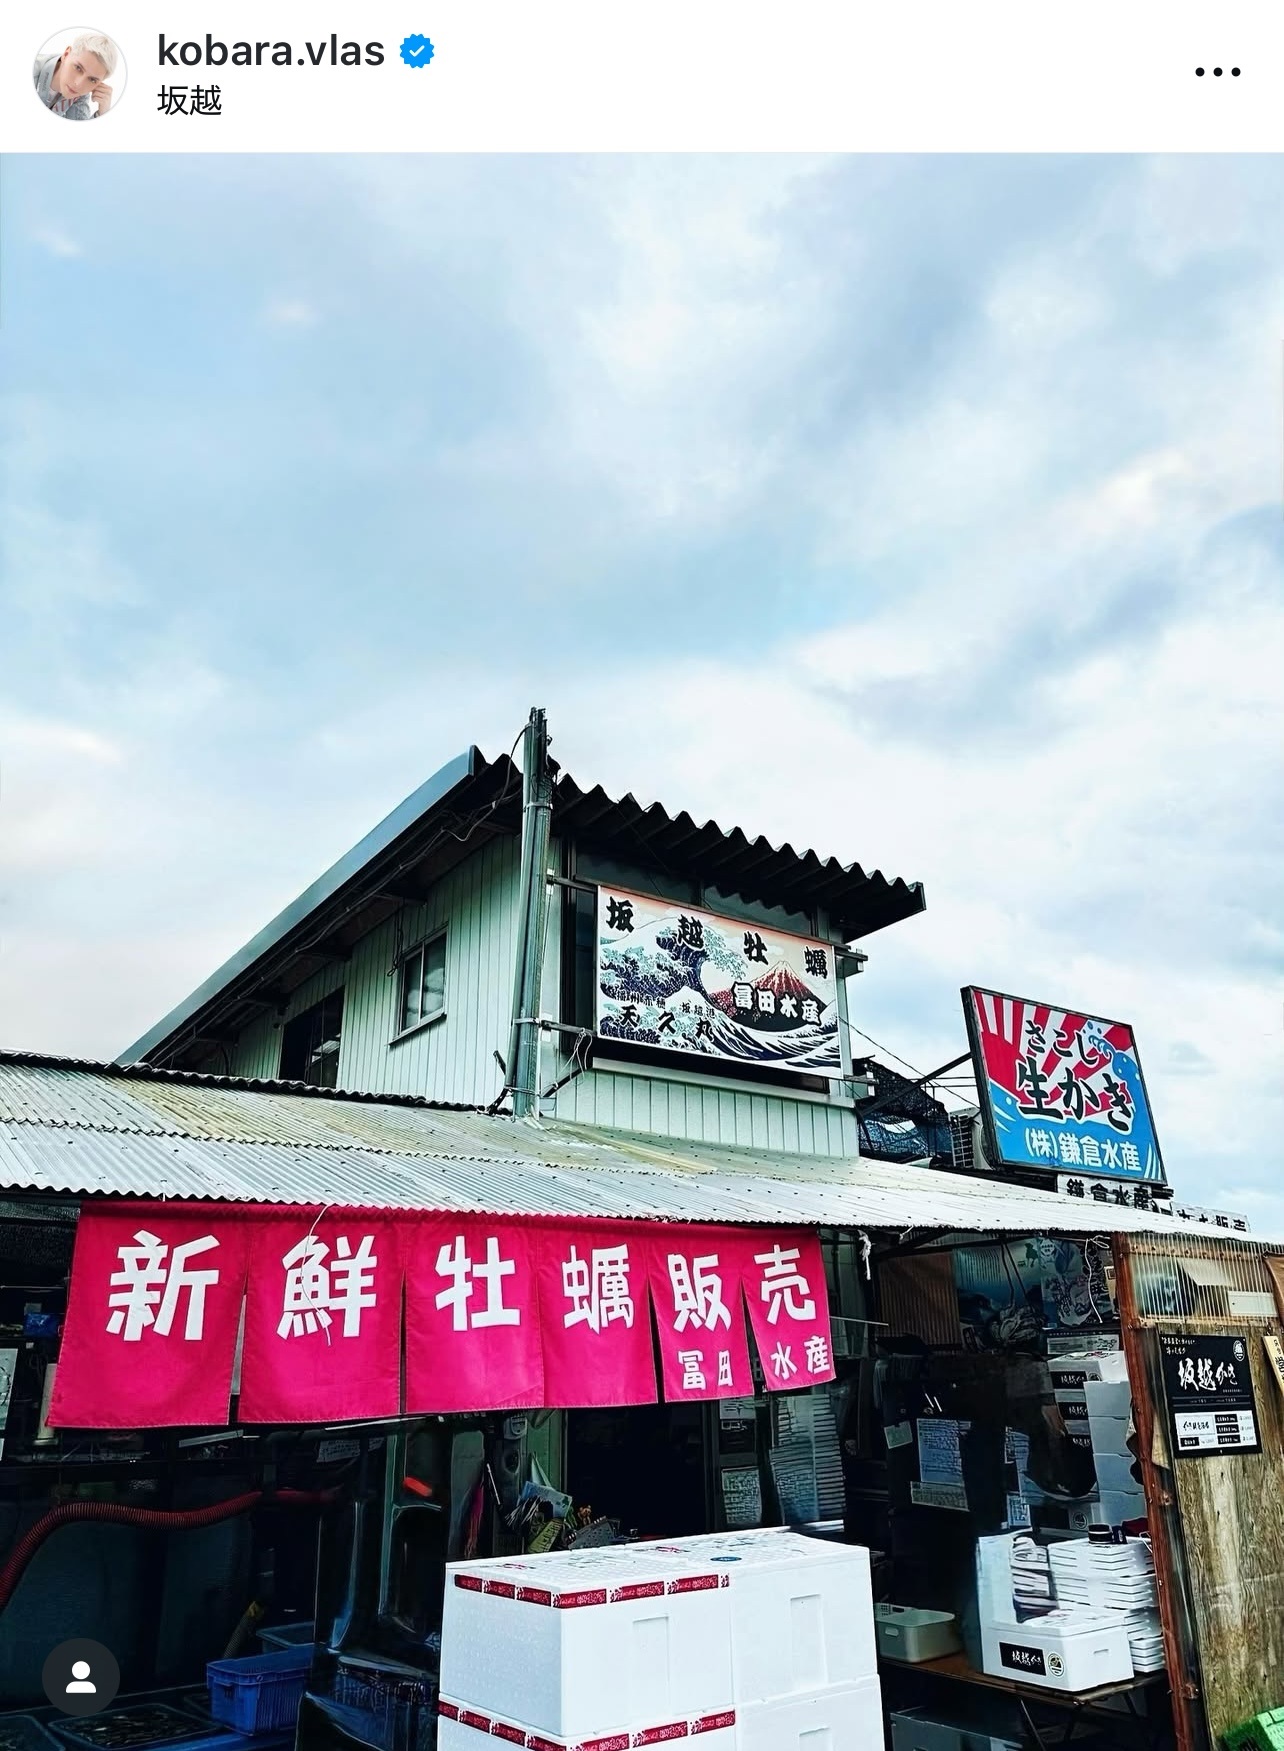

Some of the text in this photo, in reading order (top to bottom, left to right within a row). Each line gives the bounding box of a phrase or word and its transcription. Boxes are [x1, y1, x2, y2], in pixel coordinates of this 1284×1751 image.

[606, 896, 829, 979] 坂越牡蠣
[1025, 1019, 1098, 1065] さこし
[1015, 1057, 1131, 1132] 生かき
[1024, 1127, 1142, 1172] (株)鎌倉水産
[106, 1230, 817, 1341] 新鮮牡蠣販売
